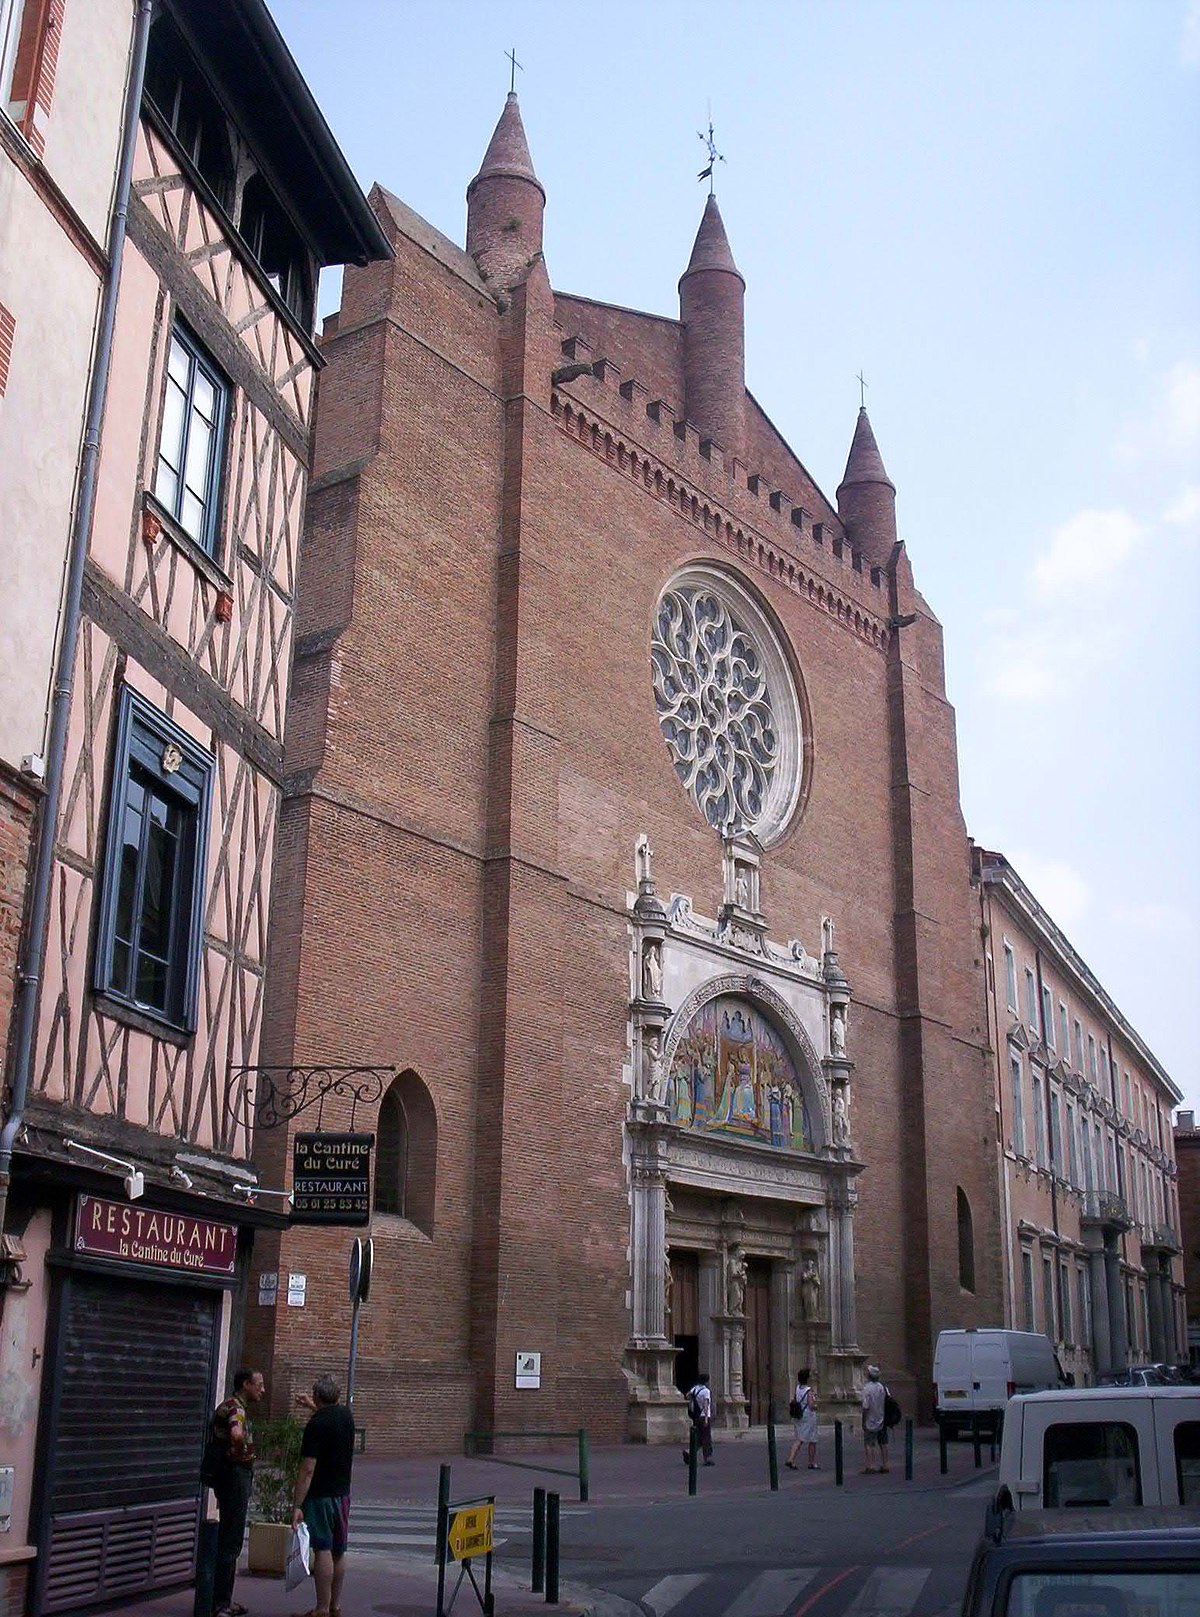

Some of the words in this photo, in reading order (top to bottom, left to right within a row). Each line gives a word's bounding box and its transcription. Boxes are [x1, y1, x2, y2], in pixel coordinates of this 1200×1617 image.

[296, 1142, 308, 1154] la
[313, 1142, 369, 1155] Cantine
[303, 1157, 320, 1169] du
[326, 1157, 360, 1170] Curé
[295, 1181, 368, 1193] RESTAURANT
[295, 1199, 308, 1209] 05
[92, 1202, 228, 1253] RESTAURANT
[119, 1238, 129, 1256] la
[131, 1240, 168, 1263] Cantine
[170, 1247, 181, 1264] du
[183, 1249, 204, 1268] Curé
